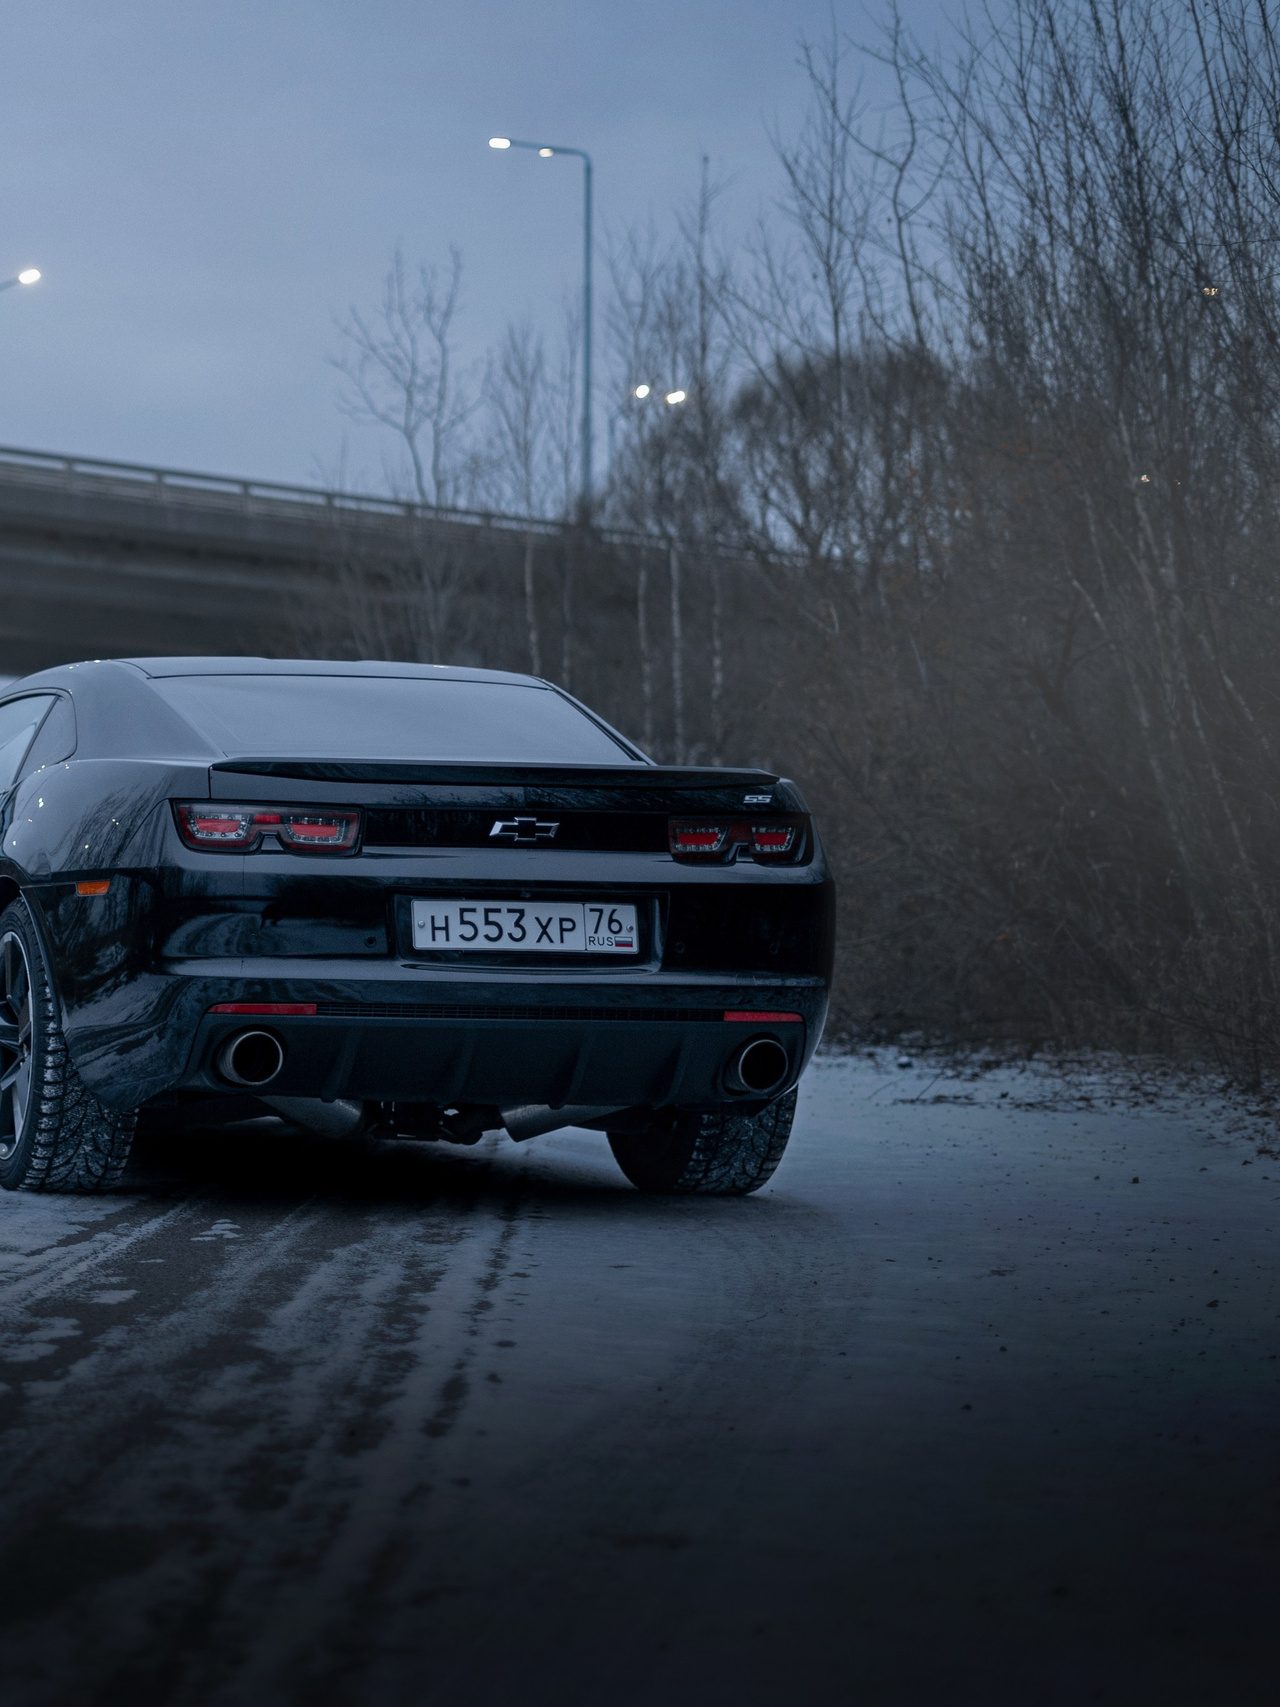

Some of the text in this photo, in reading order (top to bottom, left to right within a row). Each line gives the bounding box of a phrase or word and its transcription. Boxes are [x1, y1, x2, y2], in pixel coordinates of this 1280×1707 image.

[743, 794, 773, 804] SS
[588, 907, 623, 935] 76
[588, 935, 614, 947] RUS
